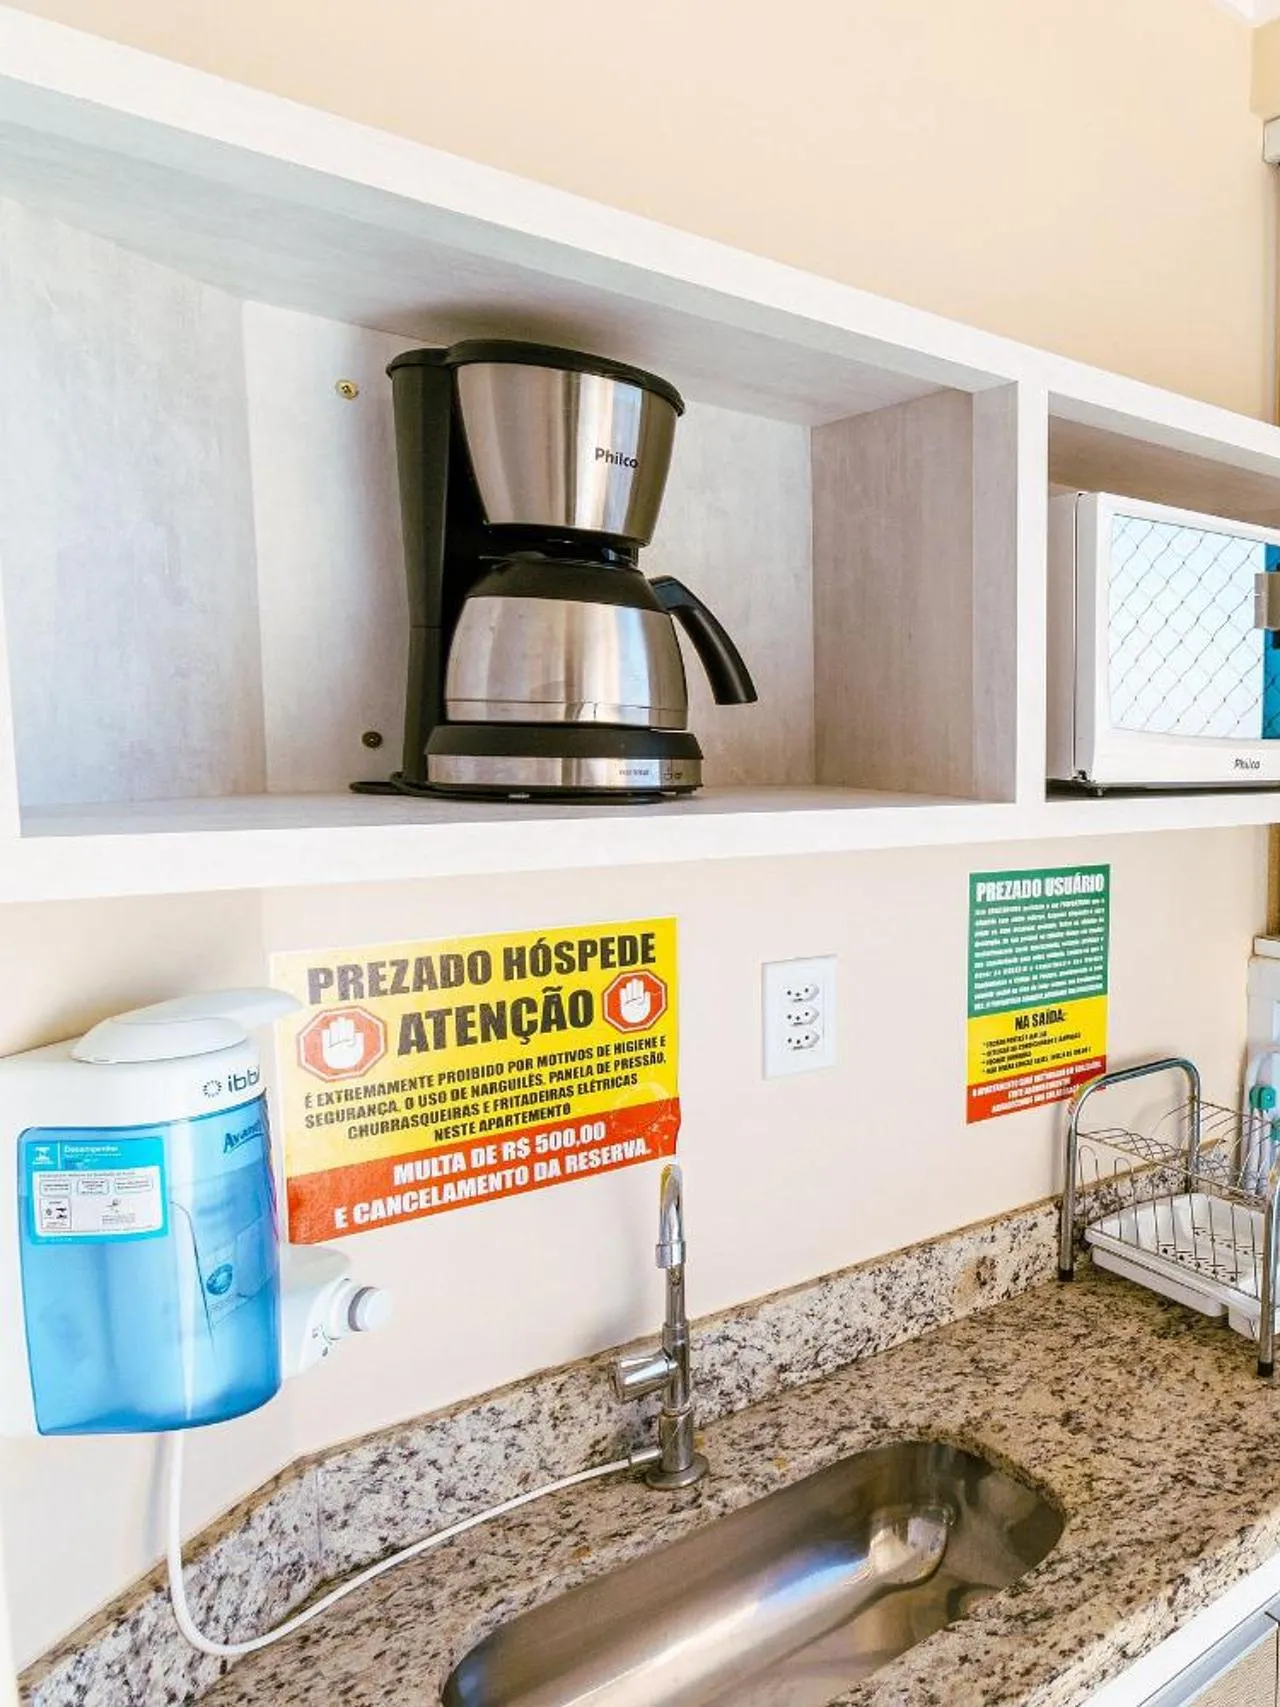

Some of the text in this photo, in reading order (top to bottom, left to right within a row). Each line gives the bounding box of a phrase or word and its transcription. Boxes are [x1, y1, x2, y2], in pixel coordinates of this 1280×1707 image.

[595, 447, 639, 469] Philco
[976, 872, 1104, 902] PREZADO USUÁRIO
[307, 933, 656, 1005] PREZADO HÓSPEDE
[397, 986, 594, 1057] ATENÇÃO
[1015, 1015, 1030, 1031] NA
[304, 1035, 667, 1109] É EXTREMAMENTE PROIBIDO POR MOTIVOS DE HIGIENE E
[404, 1096, 414, 1111] O
[418, 1090, 447, 1108] USO
[451, 1086, 467, 1101] DE
[549, 1064, 593, 1083] PANELA
[597, 1061, 611, 1075] DE
[348, 1073, 638, 1140] CHURRASQUEIRAS E FRITADEIRAS ELÉTRICAS
[434, 1102, 571, 1142] NESTE APARTEMENTO
[334, 1137, 651, 1230] E CANCELAMENTO DA RESERVA.
[393, 1121, 607, 1186] MULTA DE R$ 500,00
